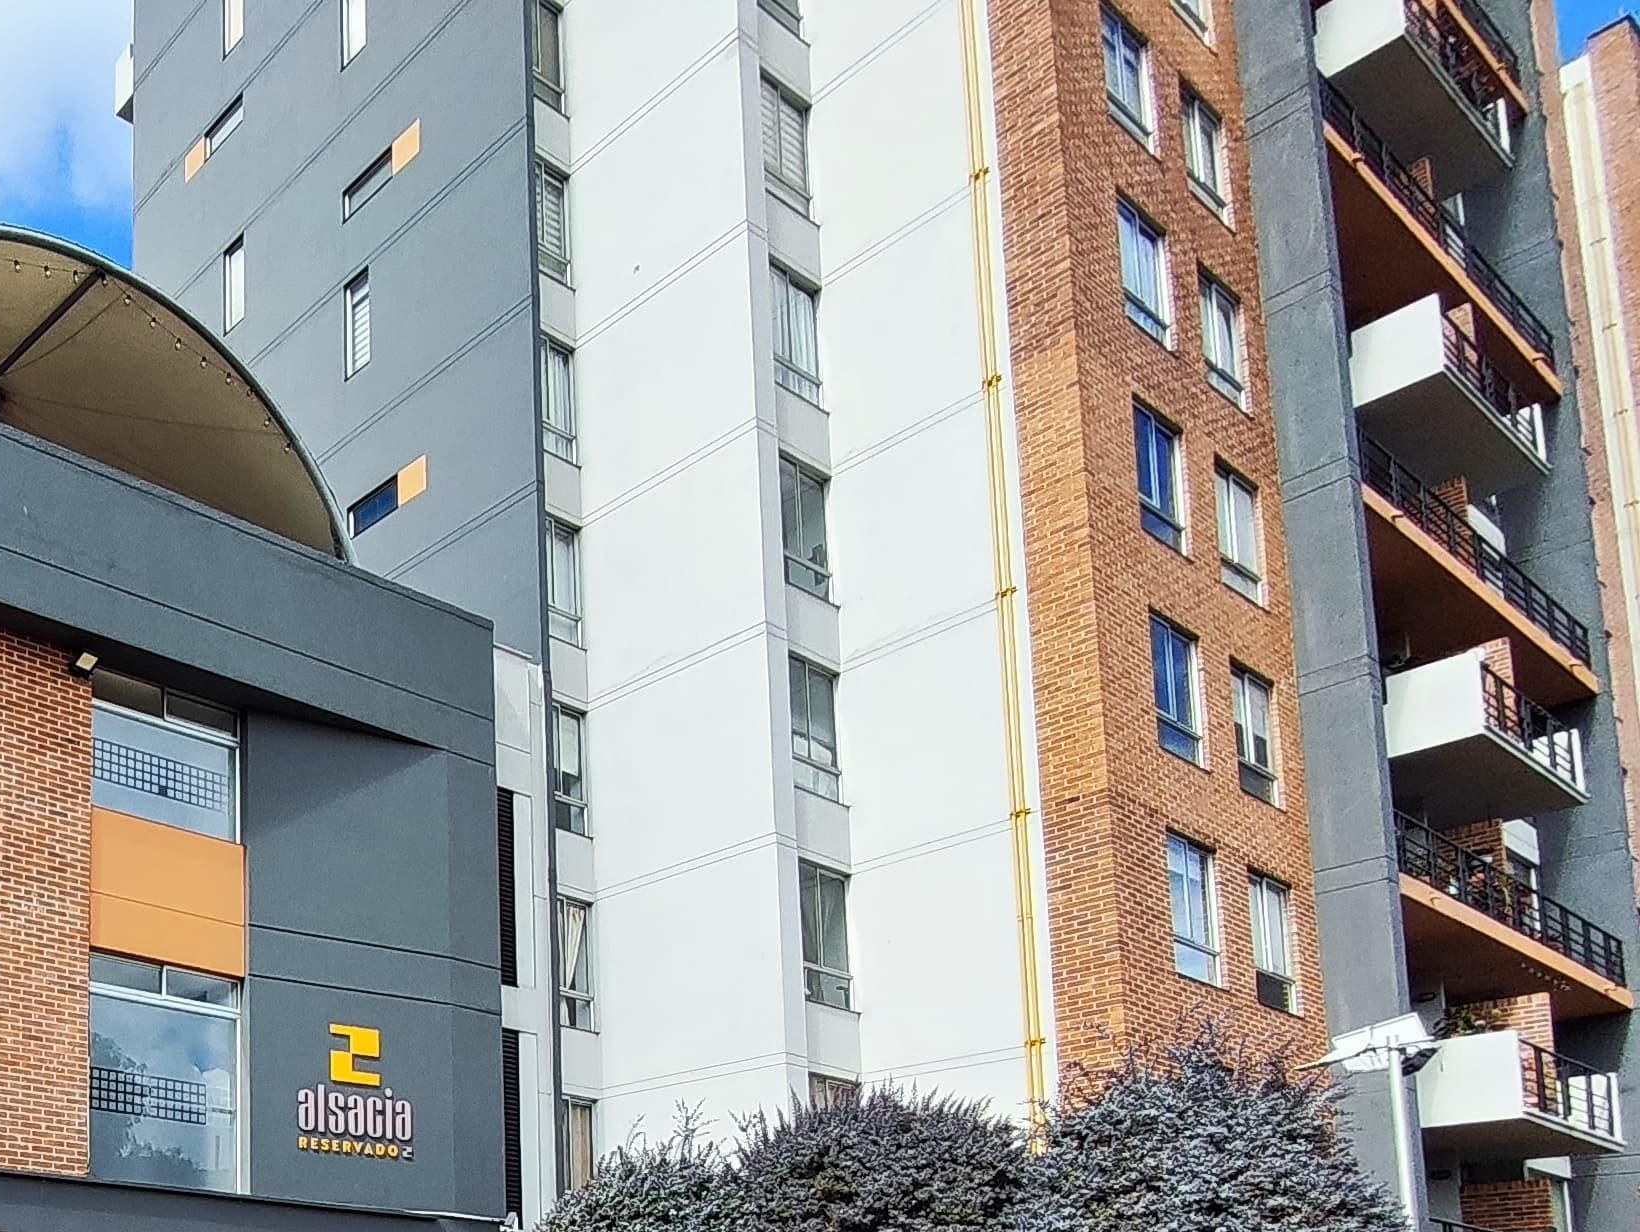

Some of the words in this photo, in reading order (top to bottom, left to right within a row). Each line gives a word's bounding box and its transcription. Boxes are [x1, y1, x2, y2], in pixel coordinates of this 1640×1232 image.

[297, 1084, 413, 1141] alsacia
[298, 1136, 399, 1157] RESERVADO
[401, 1145, 414, 1159] 2
